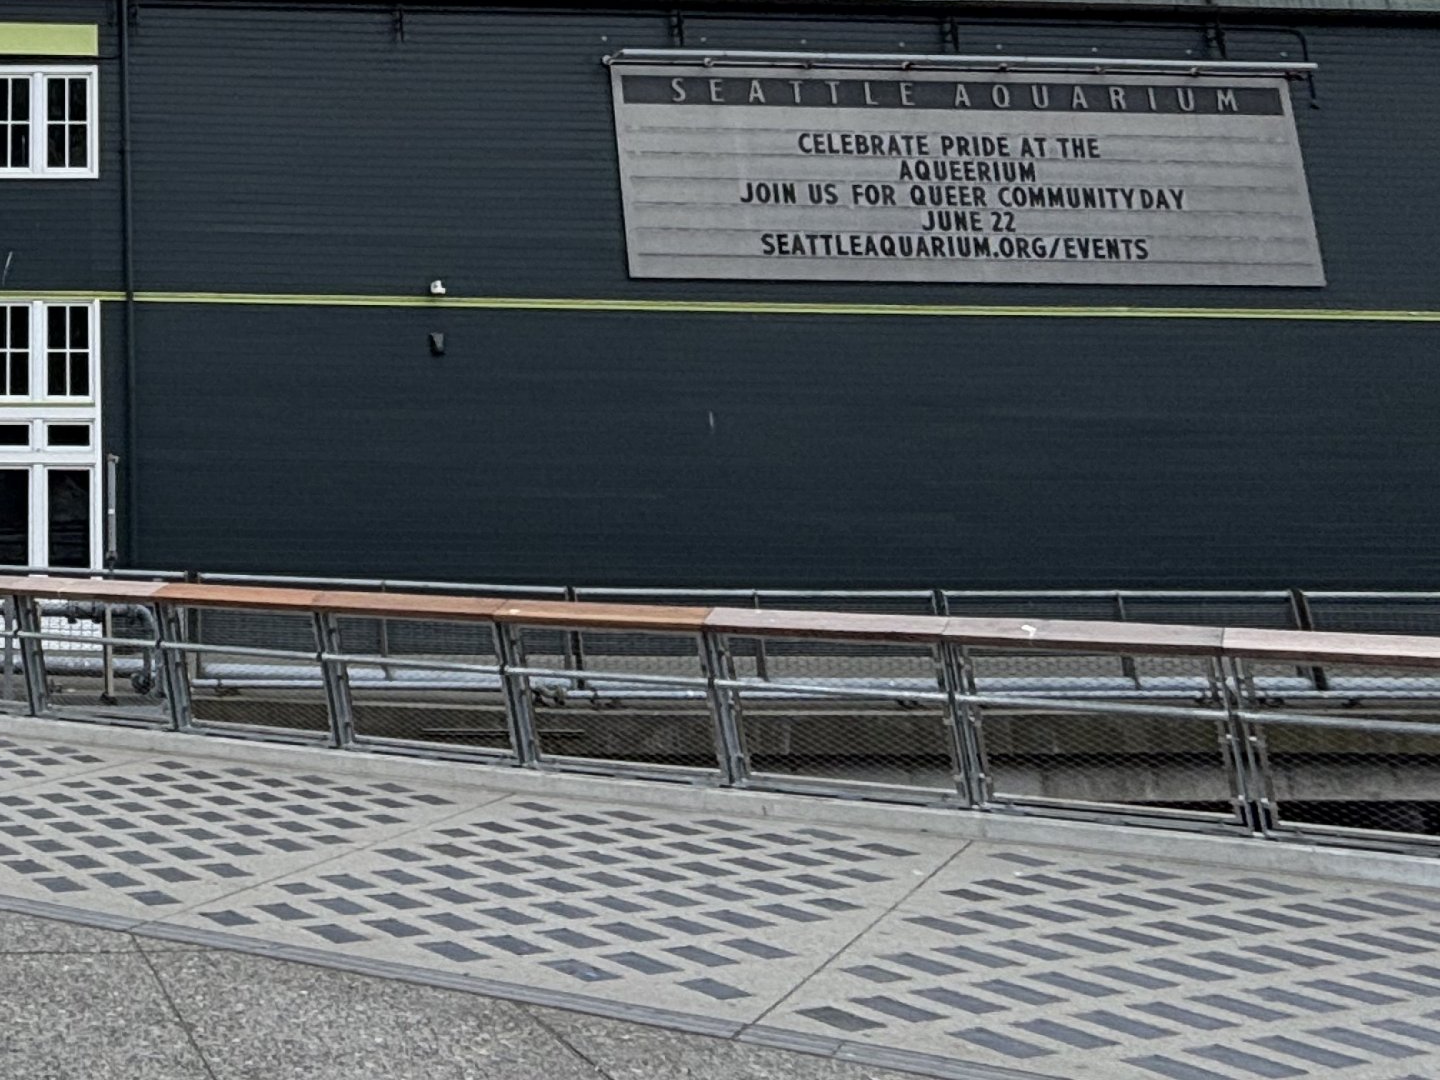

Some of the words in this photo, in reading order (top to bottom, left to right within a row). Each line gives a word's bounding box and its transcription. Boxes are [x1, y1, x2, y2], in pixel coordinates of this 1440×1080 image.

[670, 77, 916, 107] SEATTLE
[954, 83, 1239, 113] AQUARIUM
[797, 132, 931, 156] CELEBRATE
[940, 134, 1011, 158] PRIDE
[1020, 136, 1047, 158] AT
[1056, 137, 1102, 159] THE
[898, 159, 1037, 183] AQUEERIUM
[740, 182, 797, 204] JOIN
[808, 183, 839, 205] US
[852, 184, 897, 206] FOR
[909, 185, 987, 208] QUEER
[921, 210, 984, 232] JUNE
[991, 211, 1017, 233] 22
[761, 233, 1150, 260] SEATTLEAQUARIUM.ORG/EVENTS
